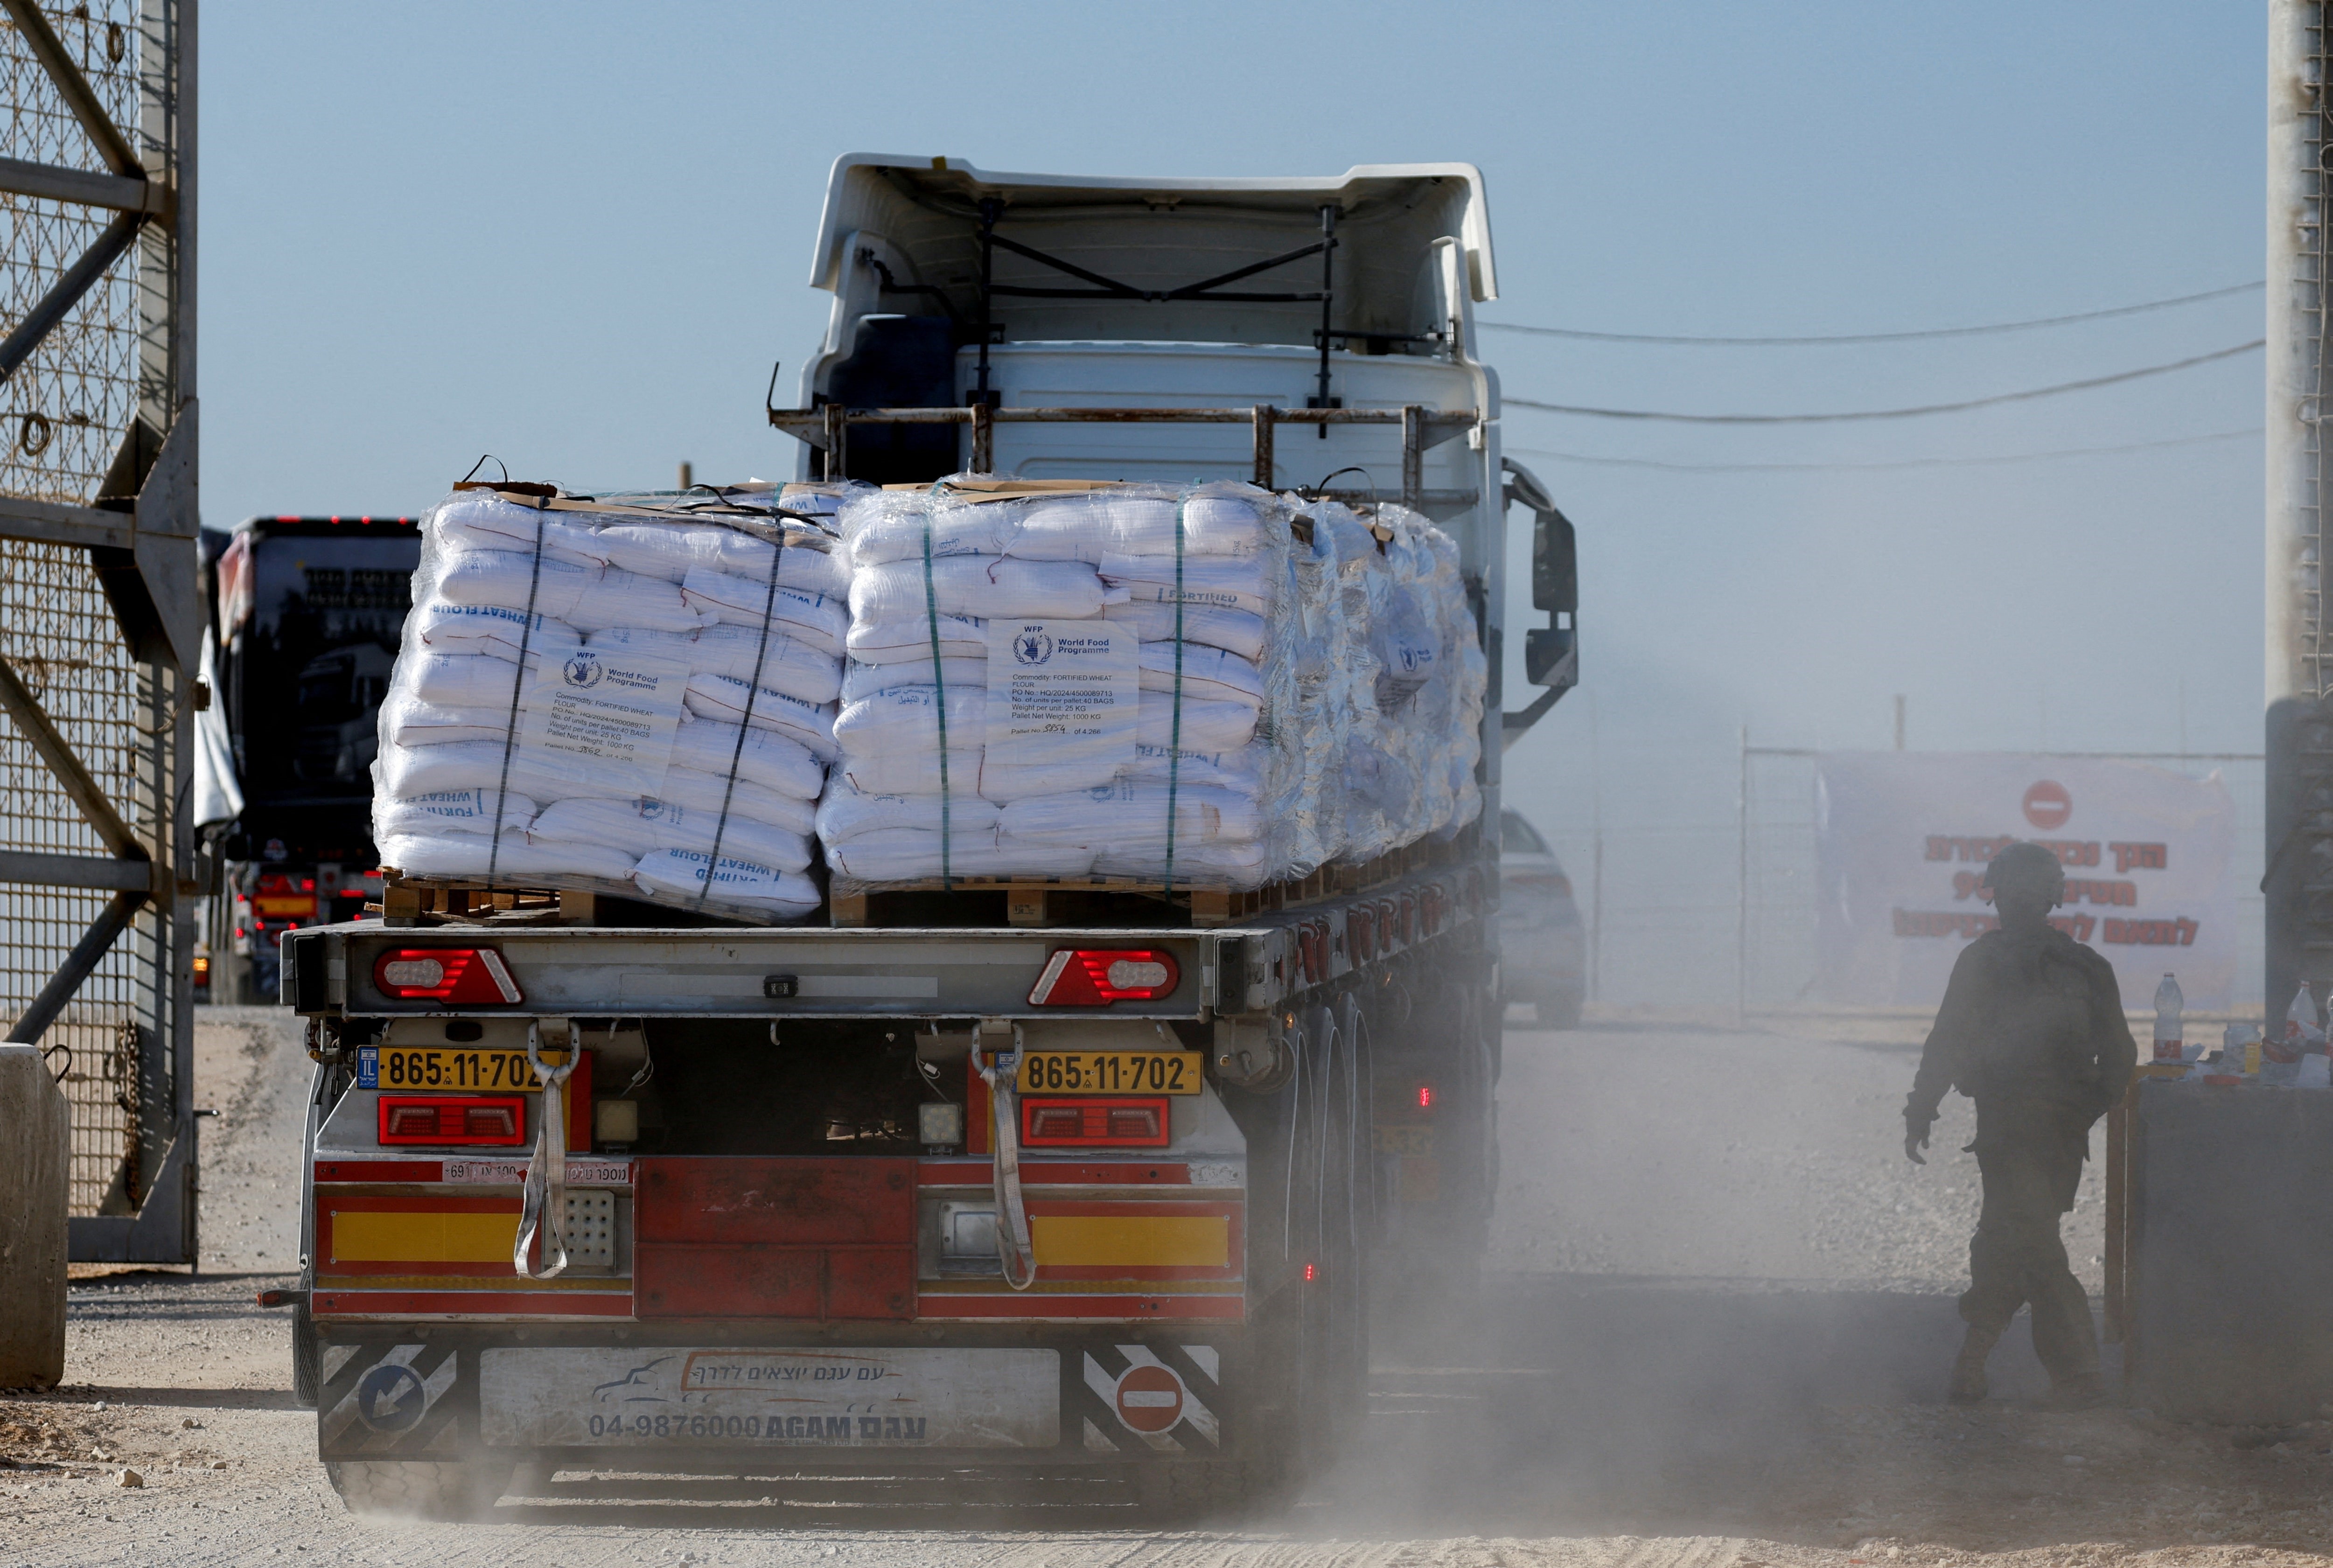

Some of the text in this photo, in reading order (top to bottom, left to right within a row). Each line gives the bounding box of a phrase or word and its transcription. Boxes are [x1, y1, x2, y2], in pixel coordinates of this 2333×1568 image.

[607, 676, 656, 690] Programme
[608, 669, 658, 683] World Food
[554, 700, 576, 709] FLOUR
[556, 692, 653, 717] Commodity: FORTIFIED WHEAT
[547, 728, 566, 738] Pallet
[567, 732, 579, 740] Net
[549, 721, 571, 731] Weight
[572, 717, 590, 725] units
[630, 729, 650, 738] BAGS
[420, 792, 470, 802] WHEAT
[2109, 842, 2167, 872] הנך
[718, 858, 769, 876] WHEAT
[2104, 915, 2199, 945] לתאם
[363, 1060, 375, 1076] IL
[596, 1169, 626, 1180] מספר
[697, 1365, 884, 1384] עם עגם יוצאים לדרך
[589, 1414, 927, 1439] 04-9876000 AGAM עגם
